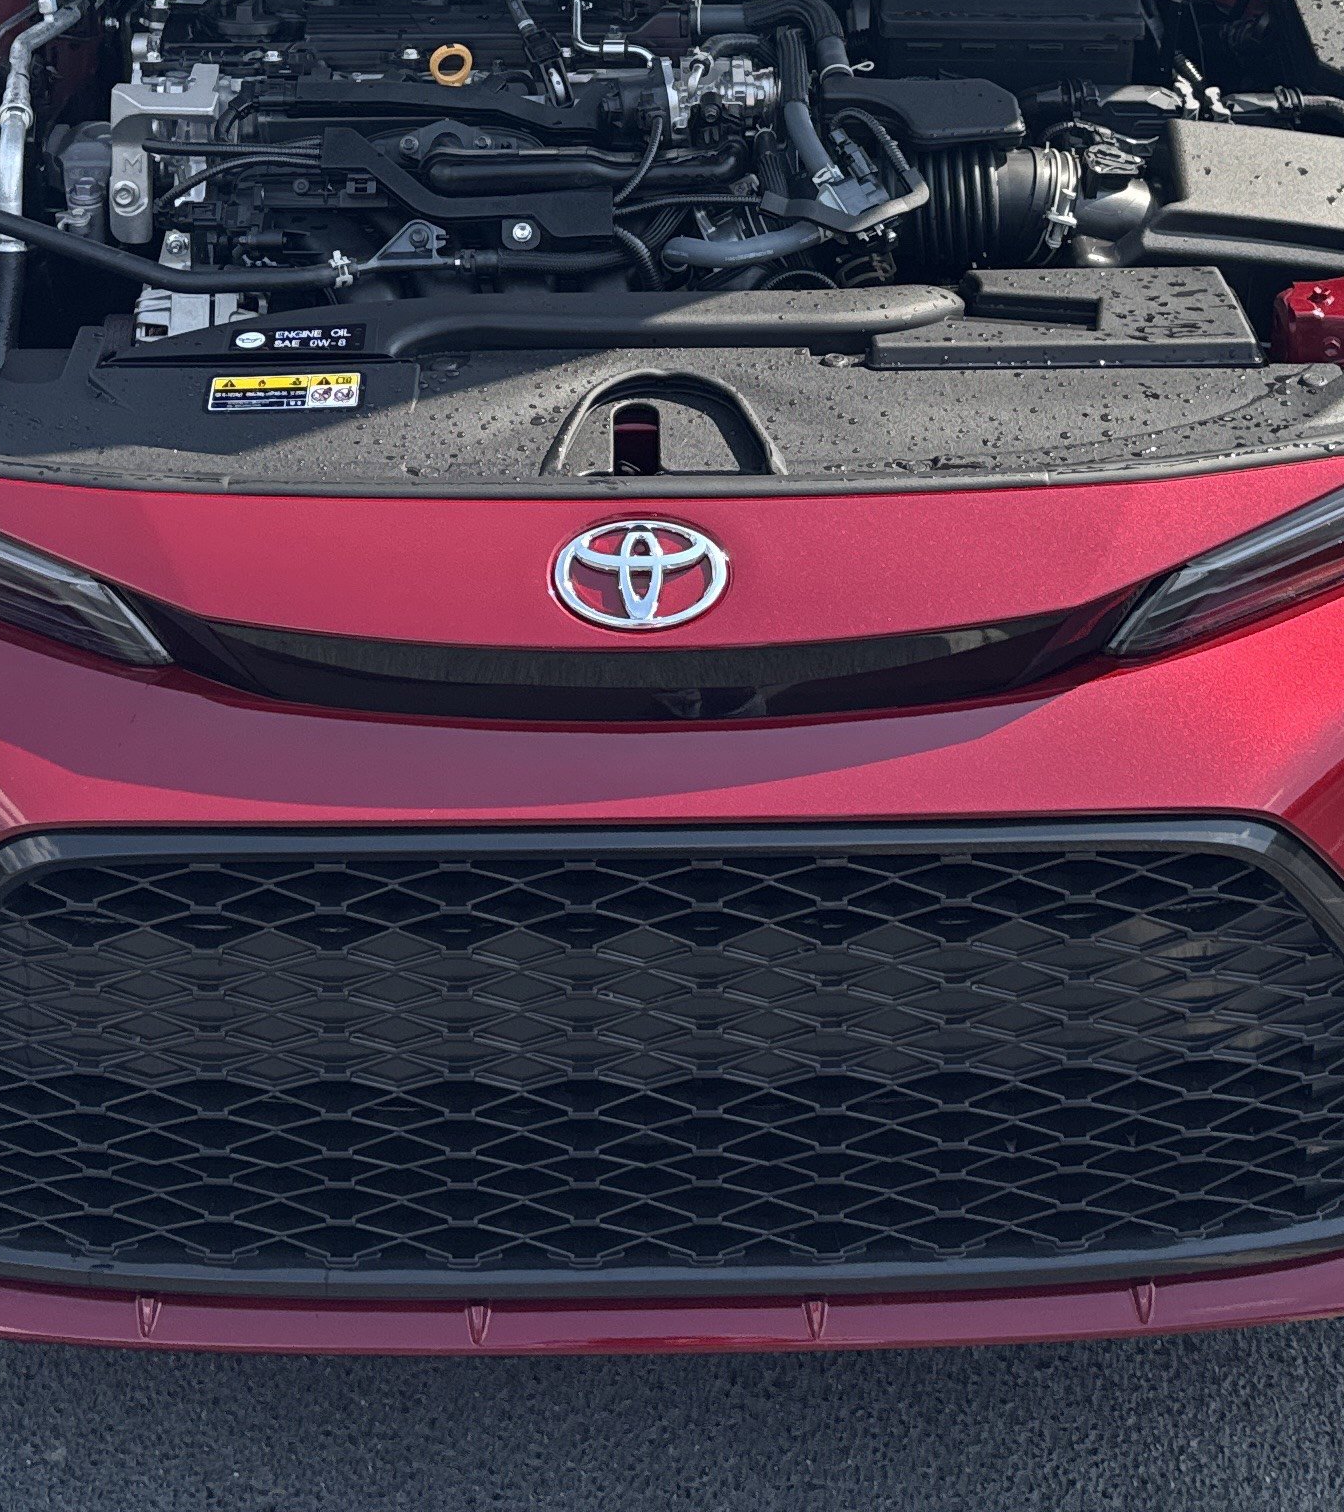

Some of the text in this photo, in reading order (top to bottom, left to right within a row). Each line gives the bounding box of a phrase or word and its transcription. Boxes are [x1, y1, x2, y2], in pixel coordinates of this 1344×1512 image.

[122, 153, 143, 174] M
[275, 328, 351, 339] ENGINE OIL
[309, 339, 346, 347] 0W-8
